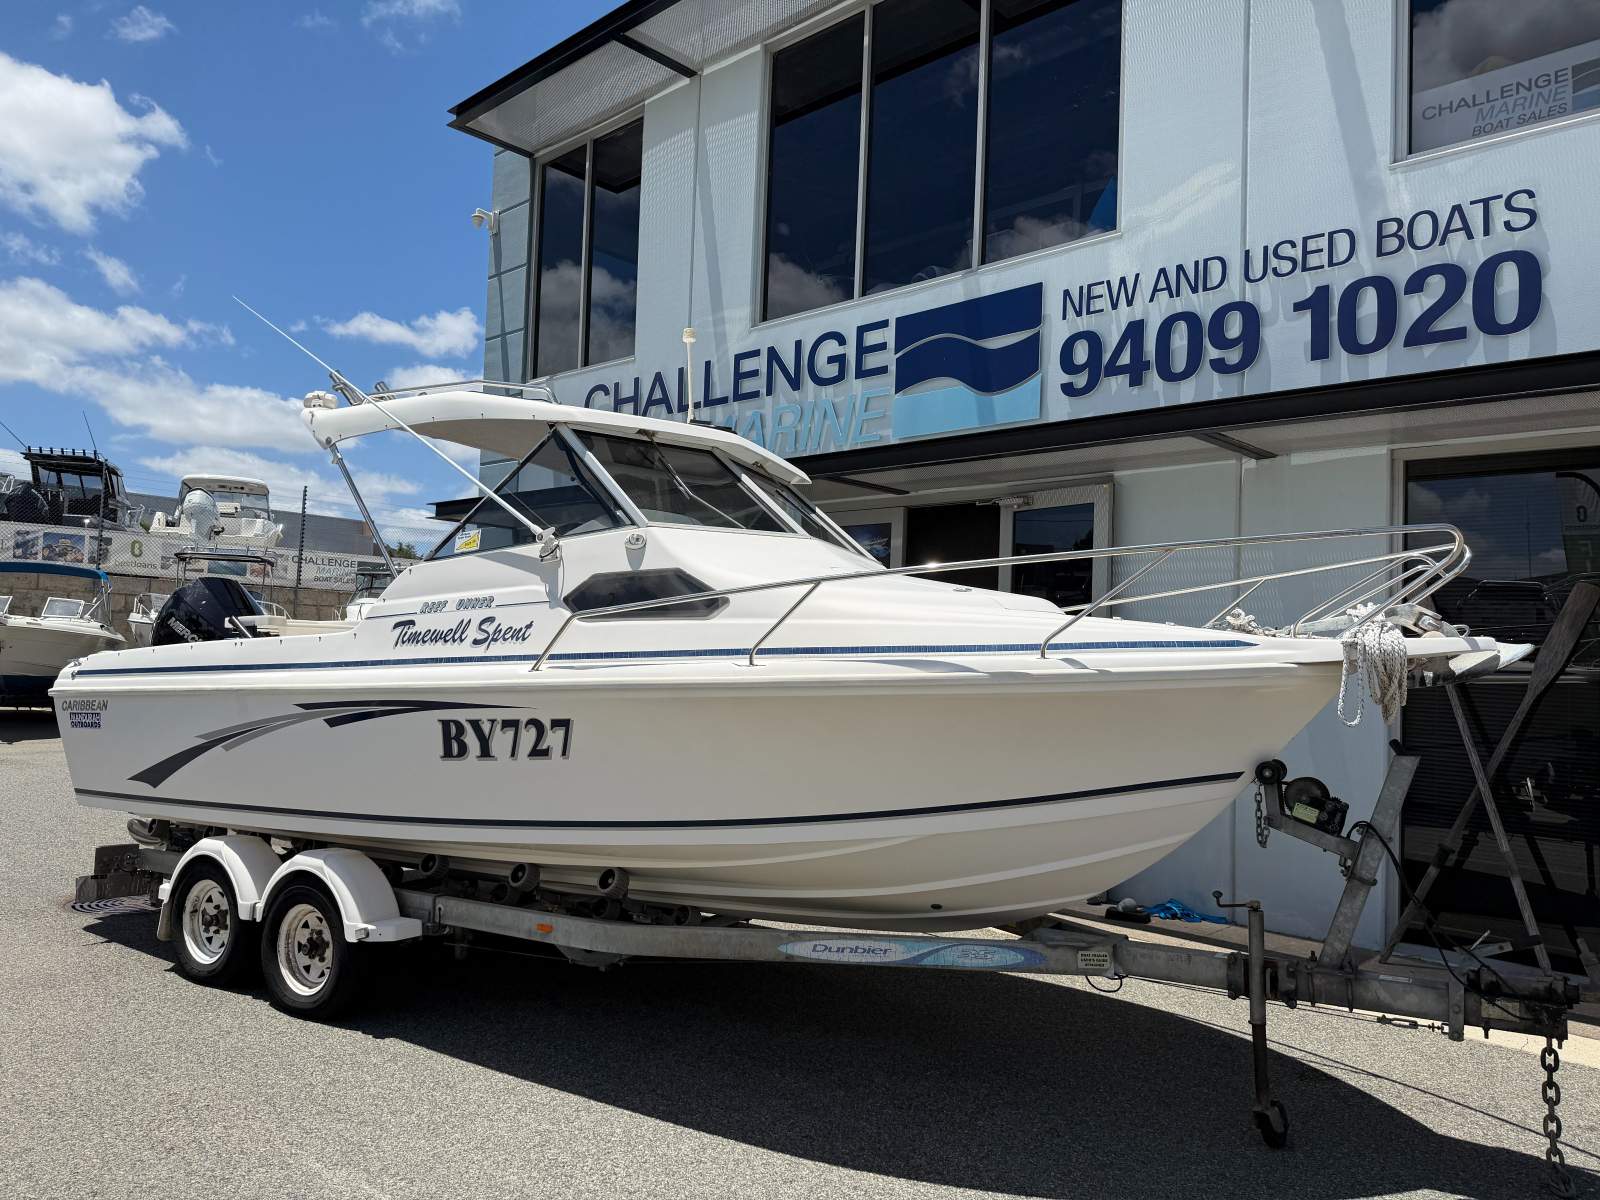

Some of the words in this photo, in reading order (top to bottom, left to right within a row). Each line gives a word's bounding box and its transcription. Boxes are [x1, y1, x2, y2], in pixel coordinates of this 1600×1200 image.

[1422, 67, 1569, 121] CHALLENGE
[1475, 84, 1568, 124] MARINE
[1472, 117, 1514, 137] BOAT
[1516, 102, 1568, 126] SALES
[1061, 272, 1140, 321] NEW
[1148, 255, 1227, 304] AND
[1244, 227, 1356, 283] USED
[1376, 188, 1539, 258] BOATS
[1059, 300, 1261, 398] 9409
[1292, 249, 1543, 362] 1020
[584, 318, 890, 418] CHALLENGE
[292, 555, 357, 568] CHALLENGE
[167, 616, 203, 643] MERC
[390, 618, 472, 649] Timewell
[471, 616, 535, 653] Spent
[61, 699, 109, 711] CARIBBEAN
[438, 718, 575, 762] BY727
[811, 943, 894, 956] Dunbier
